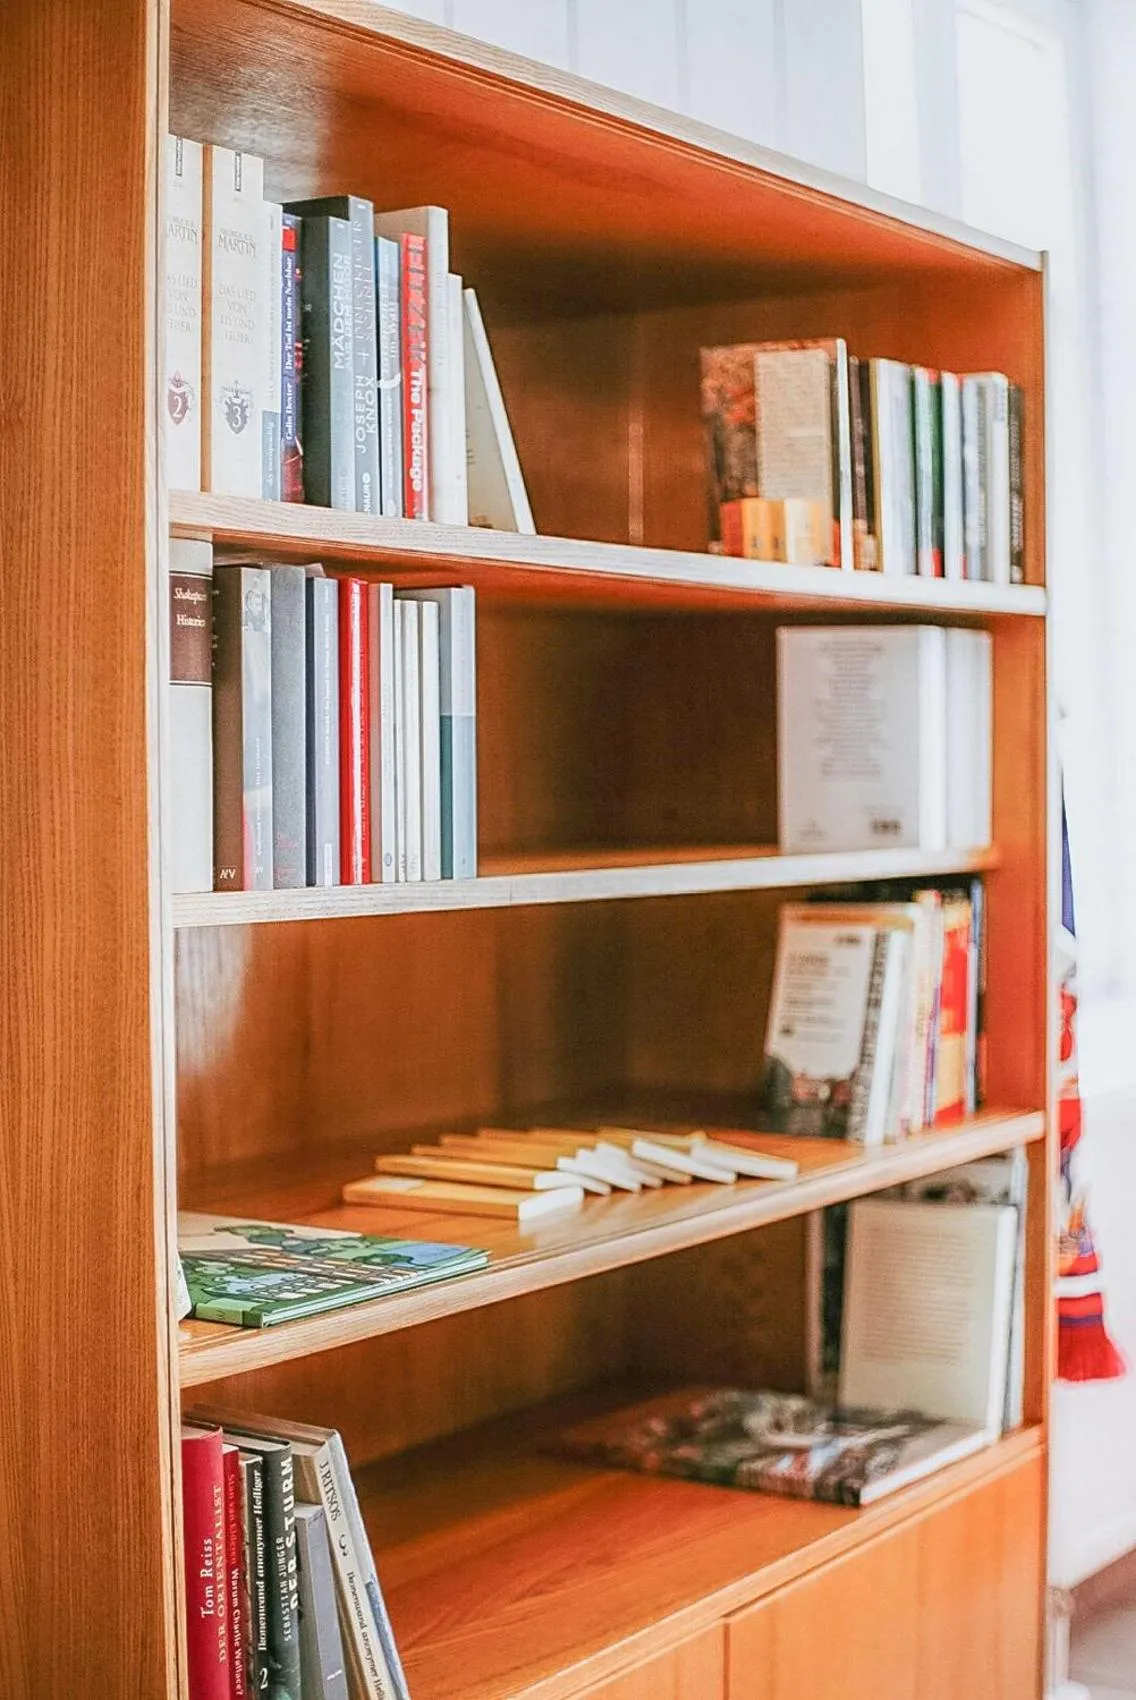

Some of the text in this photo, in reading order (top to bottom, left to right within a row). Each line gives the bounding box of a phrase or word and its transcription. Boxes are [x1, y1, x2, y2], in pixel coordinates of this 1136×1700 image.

[167, 223, 199, 245] ARTIN
[217, 233, 257, 257] MARTIN
[333, 252, 345, 370] MÄDCHEN
[172, 395, 182, 418] 2
[365, 376, 377, 434] KNOX
[410, 370, 422, 404] The
[232, 405, 242, 428] 3
[355, 374, 367, 454] JOSEPH
[409, 408, 423, 492] Package
[363, 484, 371, 512] NAUR
[281, 1456, 296, 1548] STURM
[200, 1538, 214, 1618] Tom Reiss
[214, 1485, 228, 1663] DER ORIENTALIST
[253, 1469, 267, 1651] Ikonenwand anonymer Heiliger
[231, 1568, 240, 1606] Warum
[276, 1536, 292, 1642] SEBASTIAN JUNGER
[232, 1608, 242, 1647] Charlie
[233, 1648, 245, 1696] Wallace?
[259, 1667, 269, 1690] 2
